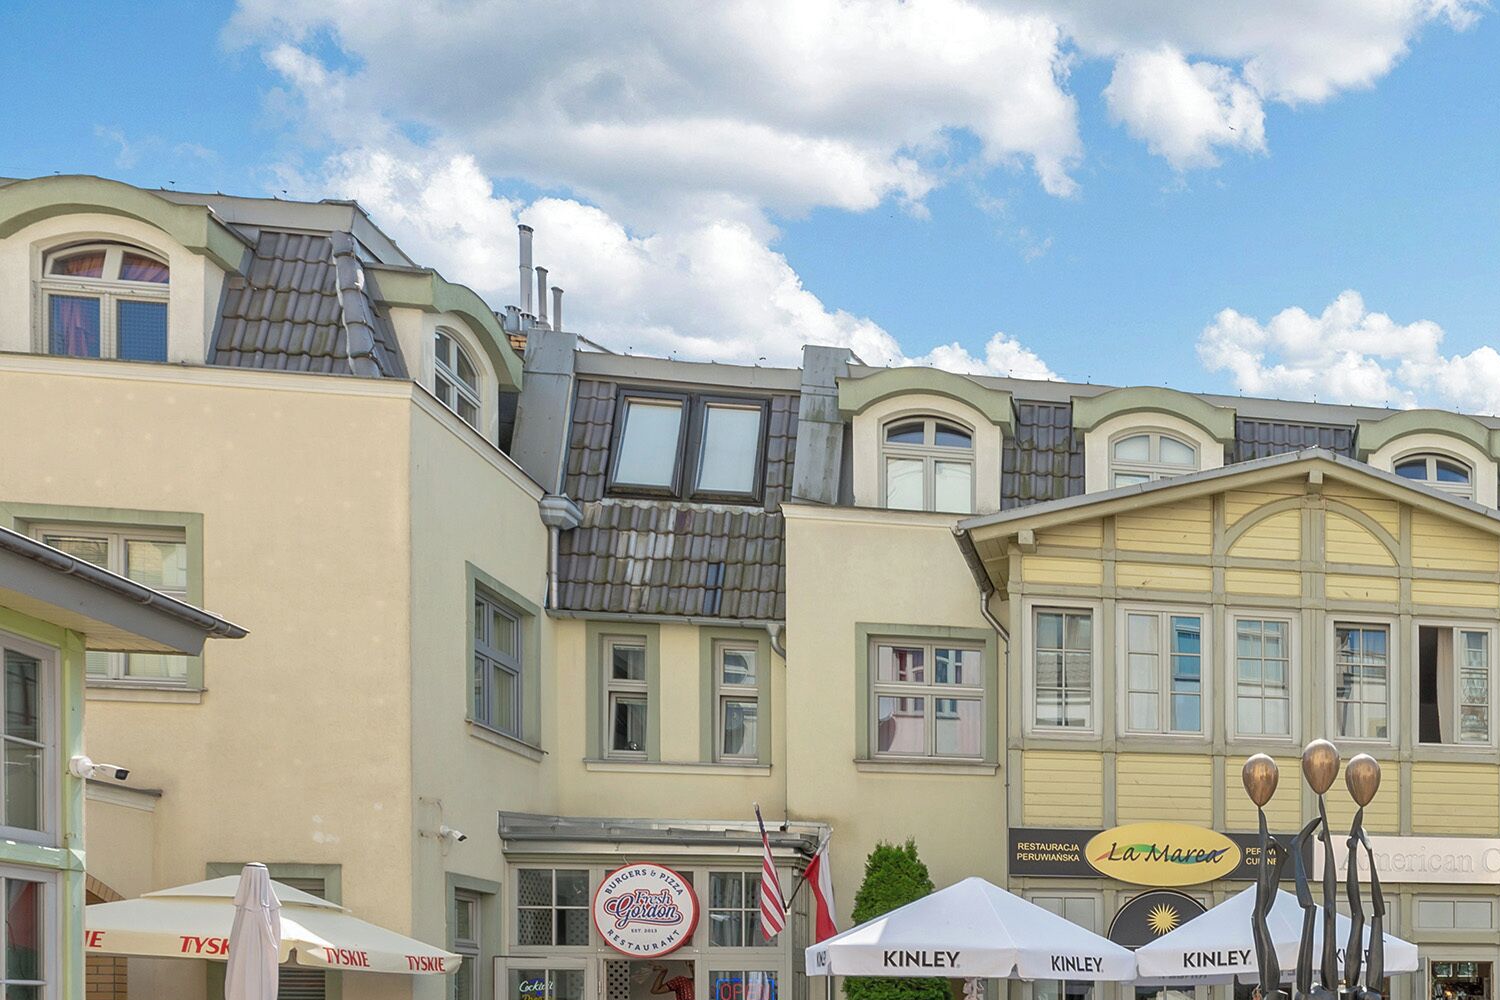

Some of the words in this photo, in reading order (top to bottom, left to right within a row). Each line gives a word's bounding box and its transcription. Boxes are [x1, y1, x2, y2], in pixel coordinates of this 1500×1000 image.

[1017, 842, 1080, 852] RESTAURACJA
[1108, 842, 1140, 861] La
[1145, 843, 1222, 864] Marea
[1016, 852, 1080, 862] PERUWIAŃSKA
[605, 869, 647, 895] BURGERS
[659, 872, 684, 896] PIZZA
[635, 890, 671, 905] Fresh
[606, 895, 681, 927] Gordon
[180, 936, 230, 955] TYSK
[607, 929, 681, 951] RESTAURANT
[323, 947, 371, 968] TYSKIE
[405, 955, 446, 972] TYSKIE
[883, 950, 961, 968] KINLEY
[1051, 955, 1103, 973] KINLEY
[1183, 950, 1252, 968] KINLEY
